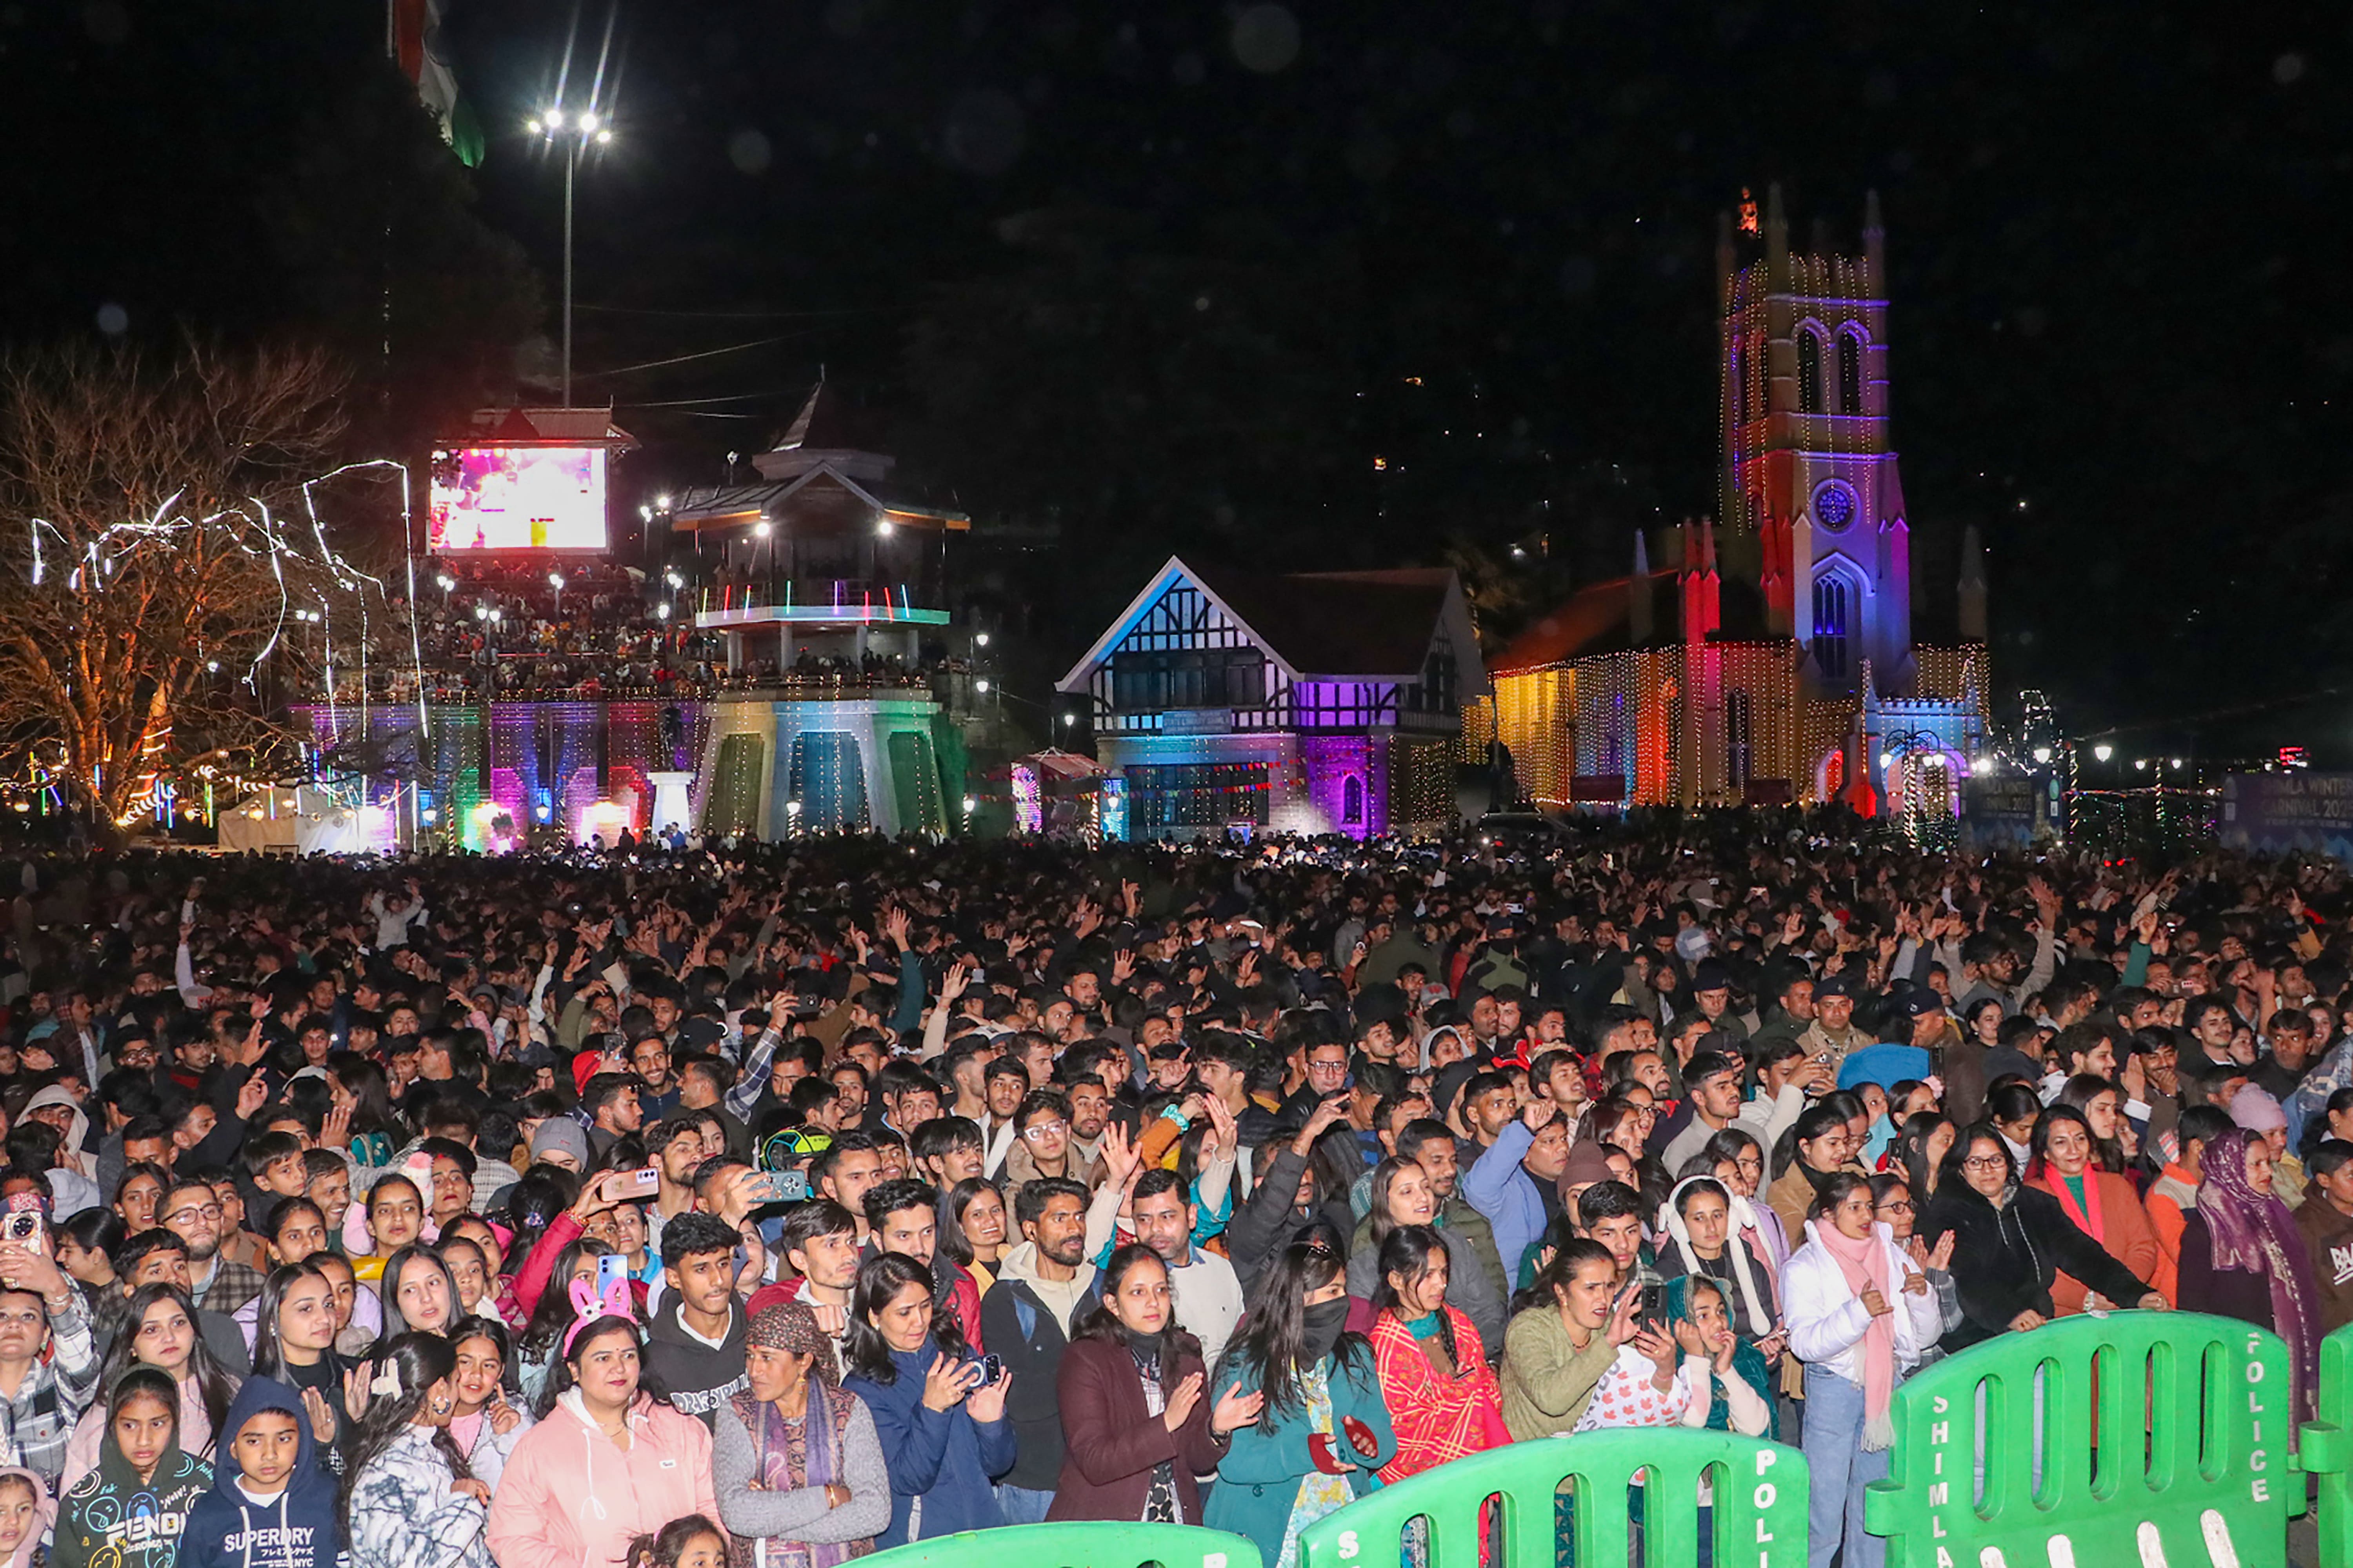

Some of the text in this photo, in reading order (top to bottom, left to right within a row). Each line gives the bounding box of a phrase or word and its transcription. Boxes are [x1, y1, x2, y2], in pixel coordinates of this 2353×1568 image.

[1929, 1395, 1954, 1568] SHIMLA
[105, 1512, 186, 1548] FENDI
[224, 1528, 314, 1552] SUPERDRY
[295, 1558, 314, 1567] NYC
